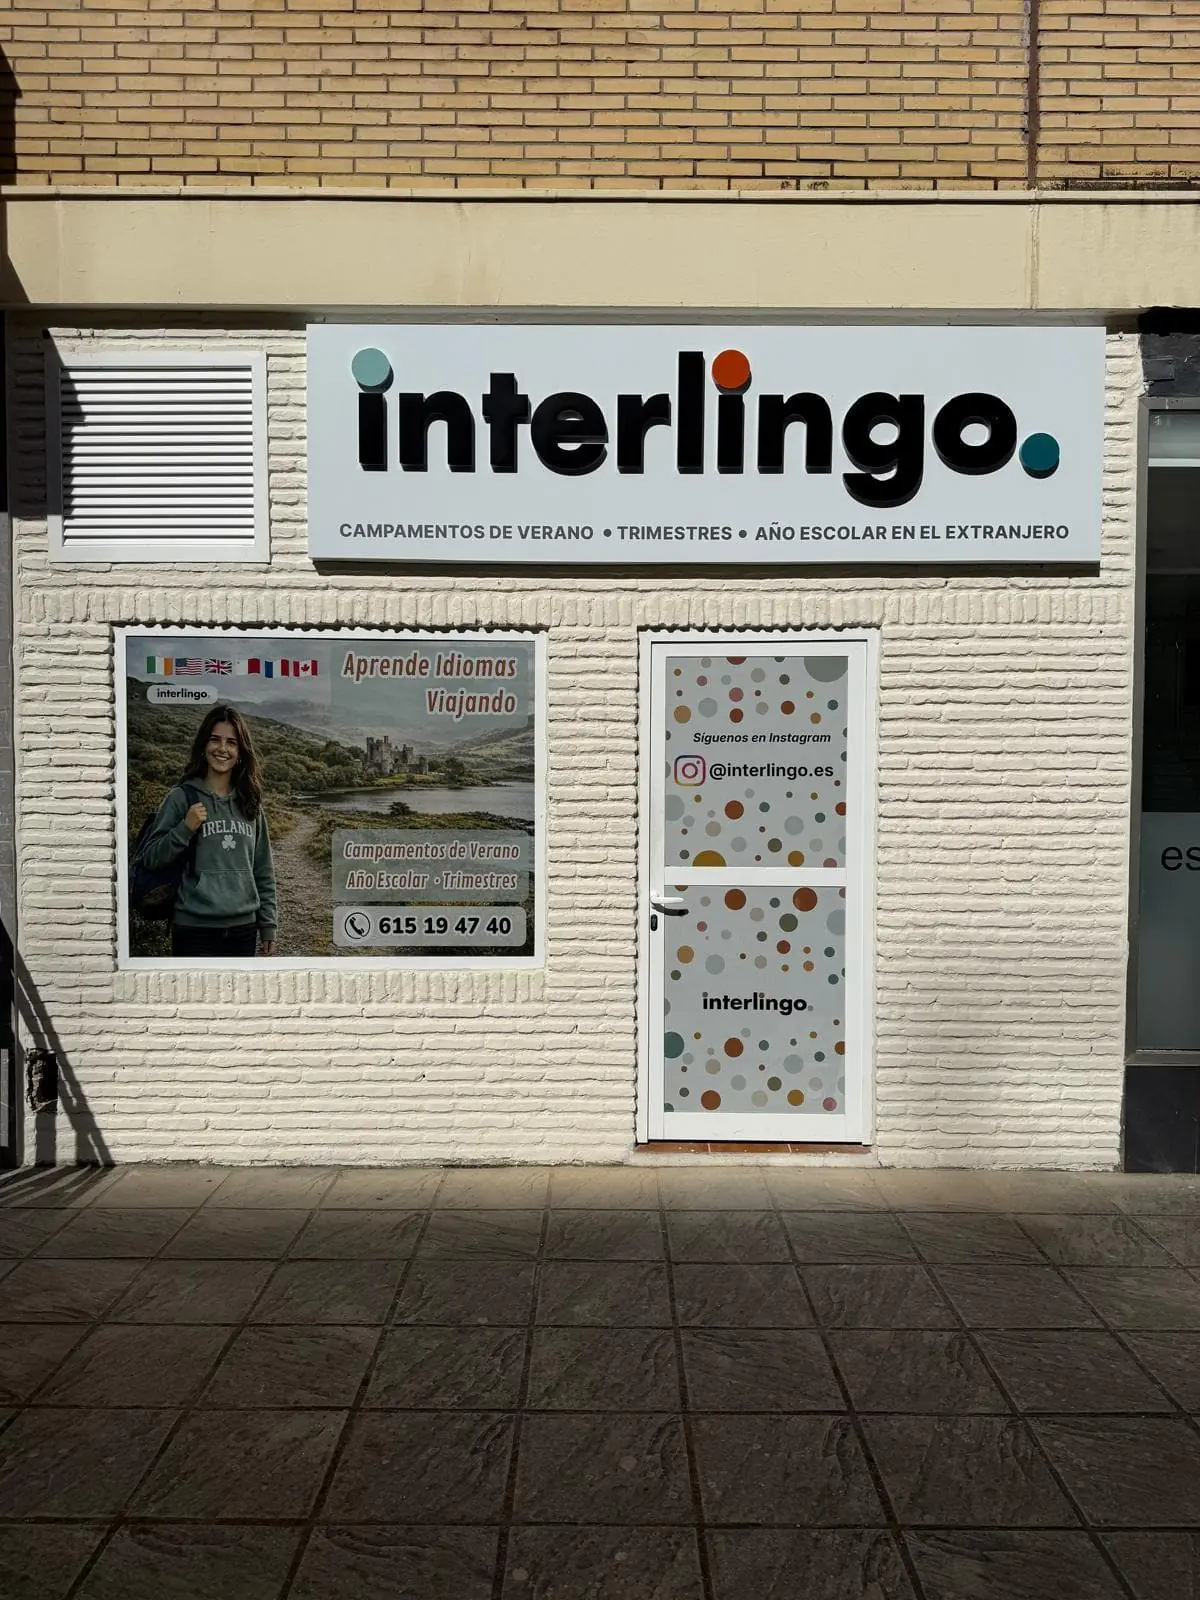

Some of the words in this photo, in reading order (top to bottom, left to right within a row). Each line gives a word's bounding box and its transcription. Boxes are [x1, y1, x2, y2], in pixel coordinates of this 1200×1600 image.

[352, 348, 1060, 508] interlingo.
[339, 523, 485, 540] CAMPAMENTOS
[489, 524, 513, 540] DE
[517, 525, 594, 540] VERANO
[617, 525, 732, 541] TRIMESTRES
[755, 521, 795, 541] AÑO
[799, 525, 887, 541] ESCOLAR
[891, 525, 916, 540] EN
[920, 525, 941, 540] EL
[945, 525, 1069, 540] EXTRANJERO
[342, 652, 430, 682] Aprende
[435, 652, 517, 678] Idiomas
[426, 689, 517, 719] Viajando
[693, 732, 749, 745] Síguenos
[751, 733, 766, 743] en
[769, 732, 831, 745] Instagram
[709, 763, 834, 780] @interlingo.es
[202, 819, 253, 838] IRELAND
[344, 842, 445, 862] Campamentos
[449, 841, 466, 859] de
[470, 842, 520, 859] Verano
[346, 870, 373, 889] Año
[377, 870, 428, 889] Escolar
[442, 871, 517, 889] Trimestres
[379, 917, 417, 934] 615
[424, 917, 448, 934] 19
[454, 917, 480, 934] 47
[486, 917, 512, 934] 40
